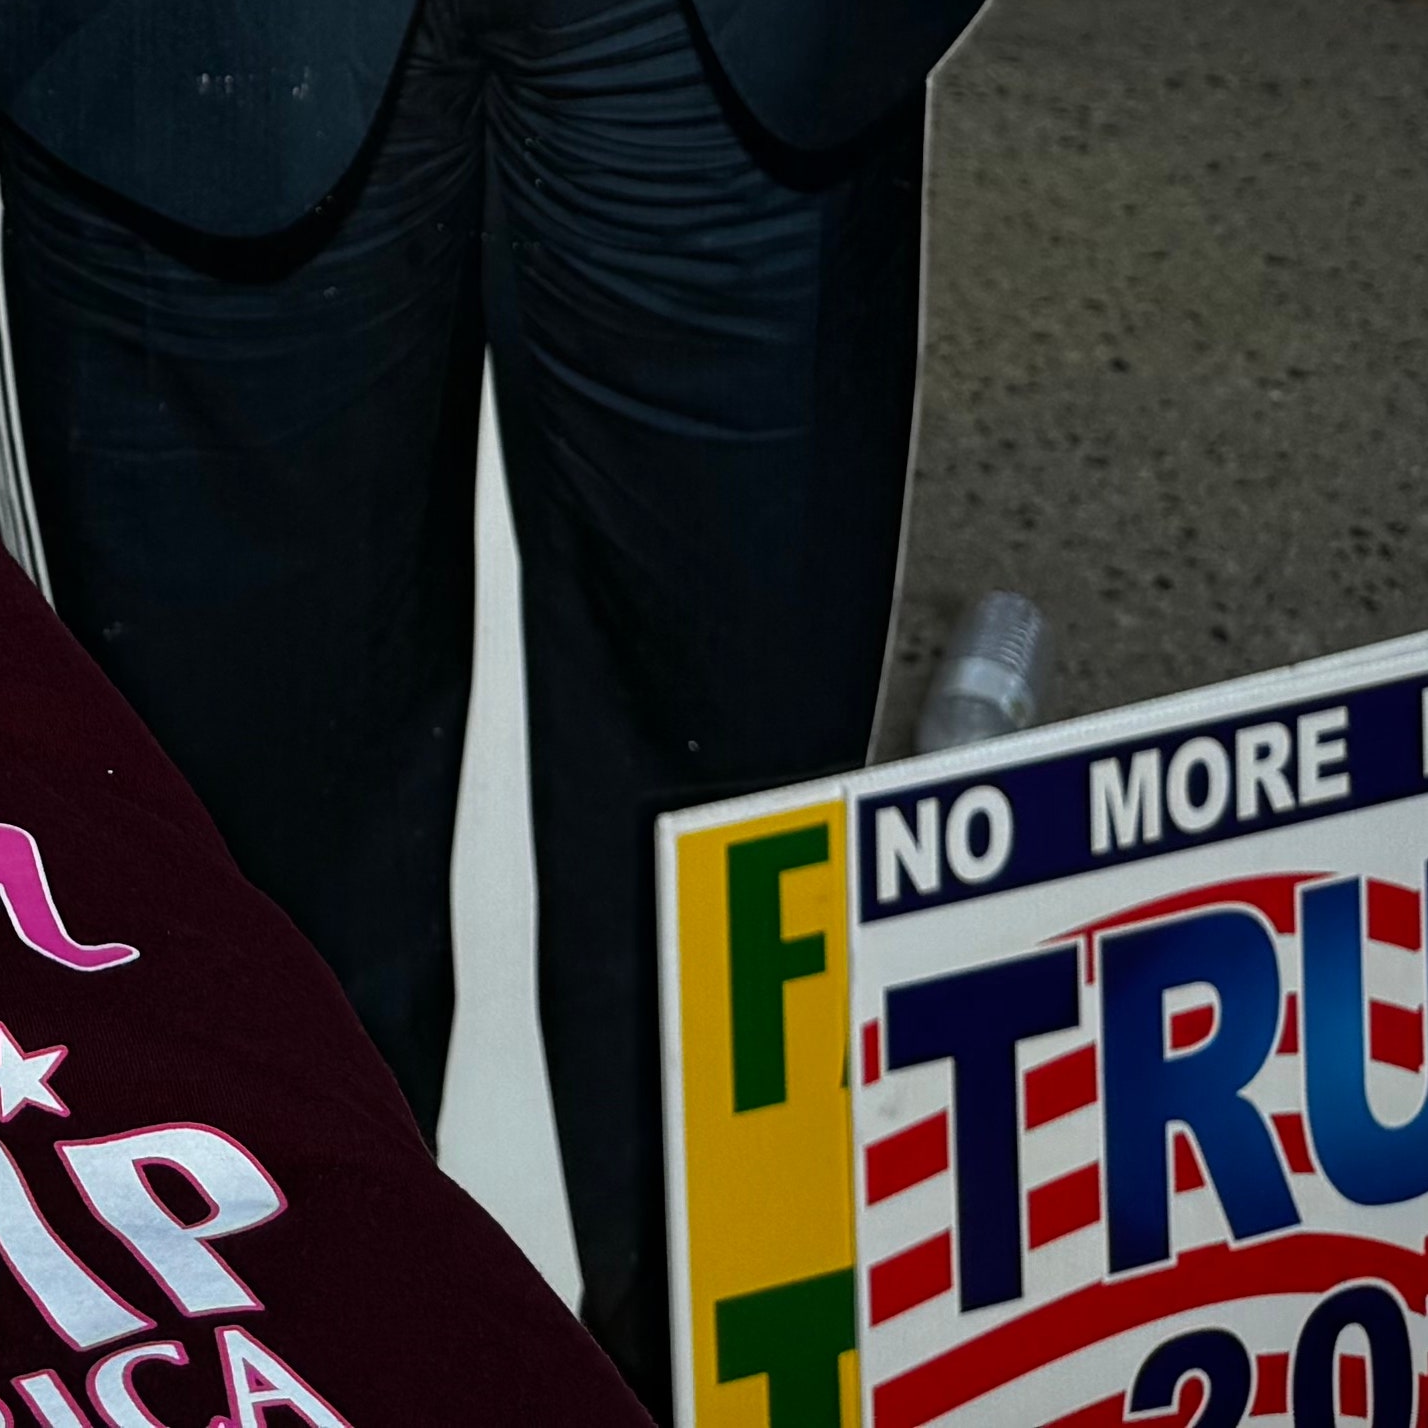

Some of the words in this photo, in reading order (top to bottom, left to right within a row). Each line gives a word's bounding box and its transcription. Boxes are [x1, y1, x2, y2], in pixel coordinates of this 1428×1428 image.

[874, 785, 1013, 904] NO
[1089, 706, 1351, 855] MORE
[882, 875, 1428, 1316] TRU
